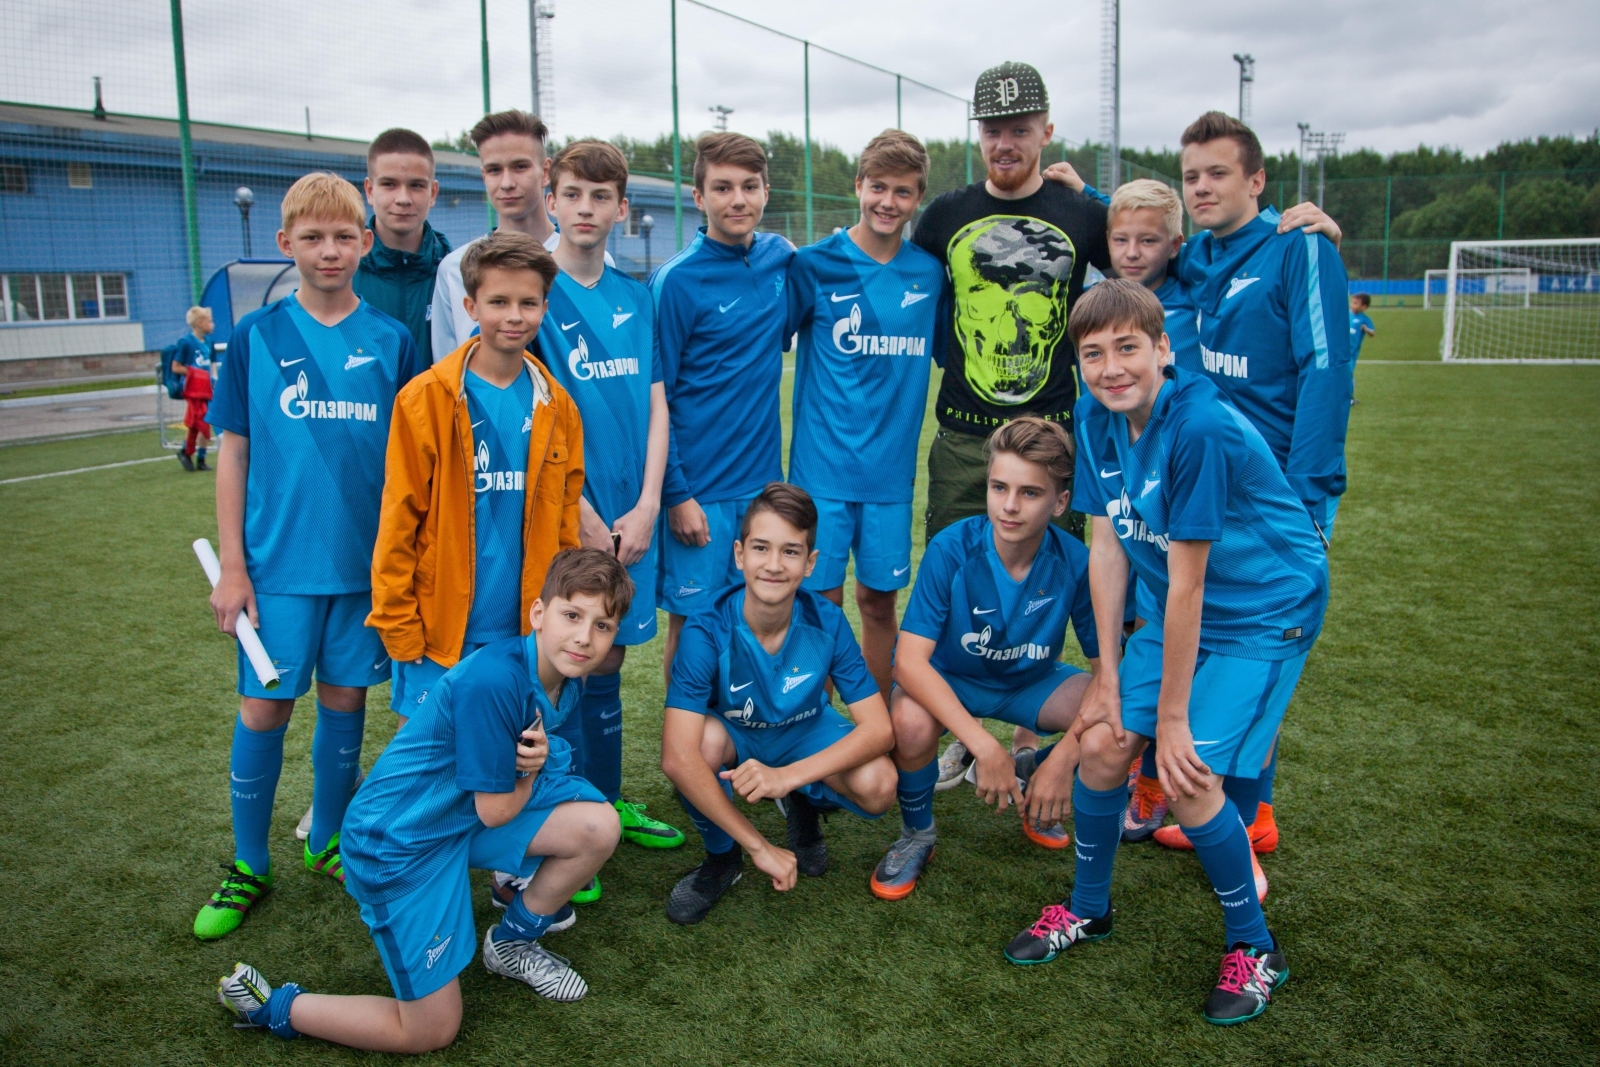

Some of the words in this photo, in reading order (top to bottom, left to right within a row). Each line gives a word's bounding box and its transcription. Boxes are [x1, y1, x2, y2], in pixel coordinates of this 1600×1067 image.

[992, 77, 1019, 107] P
[862, 335, 926, 357] ГАЗПРОМ
[344, 354, 376, 371] Зен
[1200, 342, 1248, 379] ПРОМ
[310, 400, 378, 422] ГАЗПРОМ
[1044, 410, 1071, 422] EIN
[492, 470, 526, 492] ГАЗП
[675, 585, 703, 598] Зен
[986, 642, 1051, 661] ГАЗПРОМ
[901, 803, 927, 812] ЕНИТ
[1075, 844, 1094, 862] НИТ
